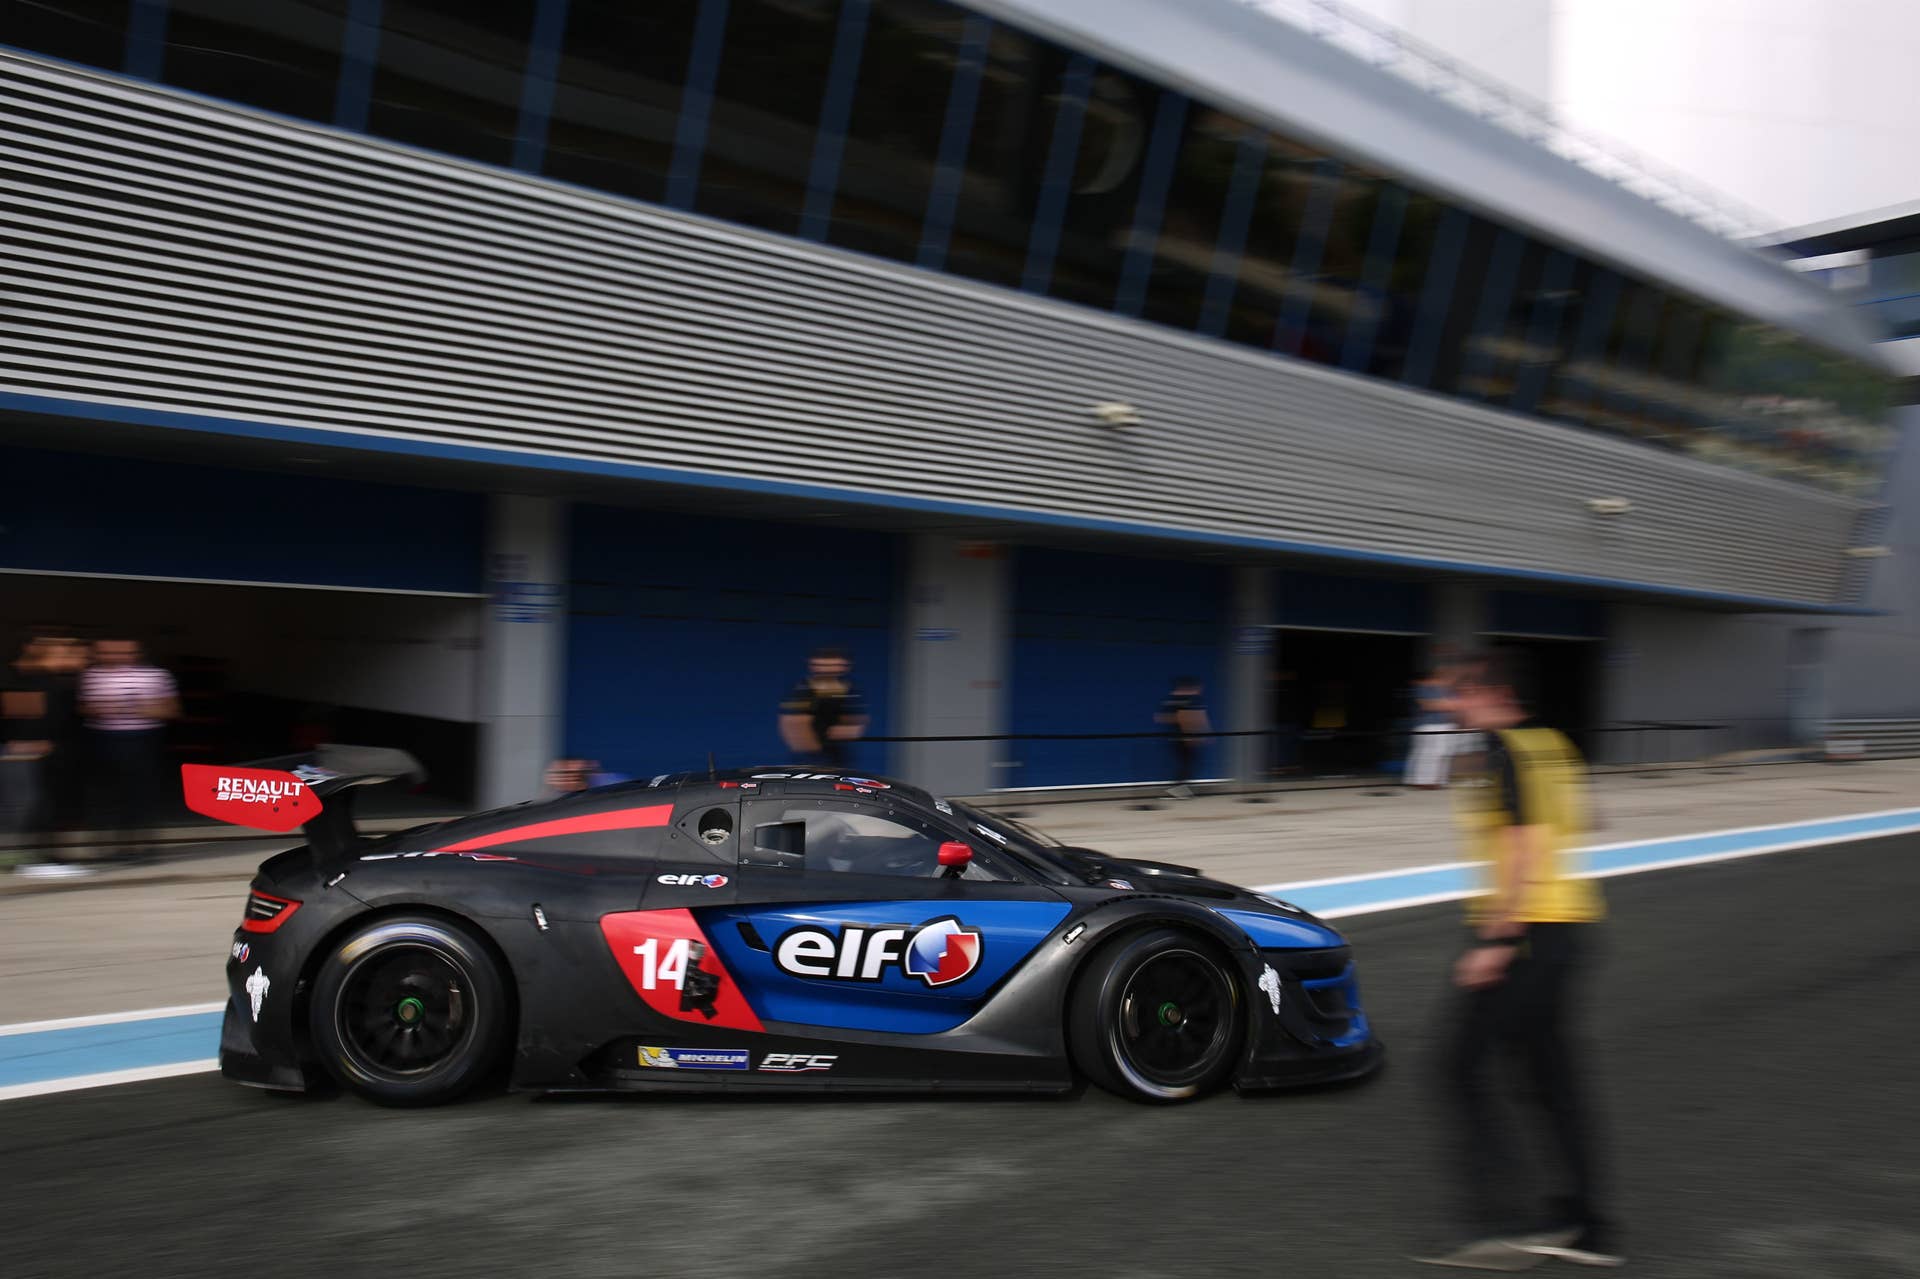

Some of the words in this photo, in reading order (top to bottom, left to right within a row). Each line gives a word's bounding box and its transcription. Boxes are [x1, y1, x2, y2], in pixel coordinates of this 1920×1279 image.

[217, 777, 305, 796] RENAULT
[216, 791, 282, 804] SPORT
[657, 874, 703, 886] elf
[777, 928, 905, 979] elf
[633, 938, 690, 991] 14
[678, 1053, 748, 1064] MICHELIN
[761, 1053, 839, 1067] PFC
